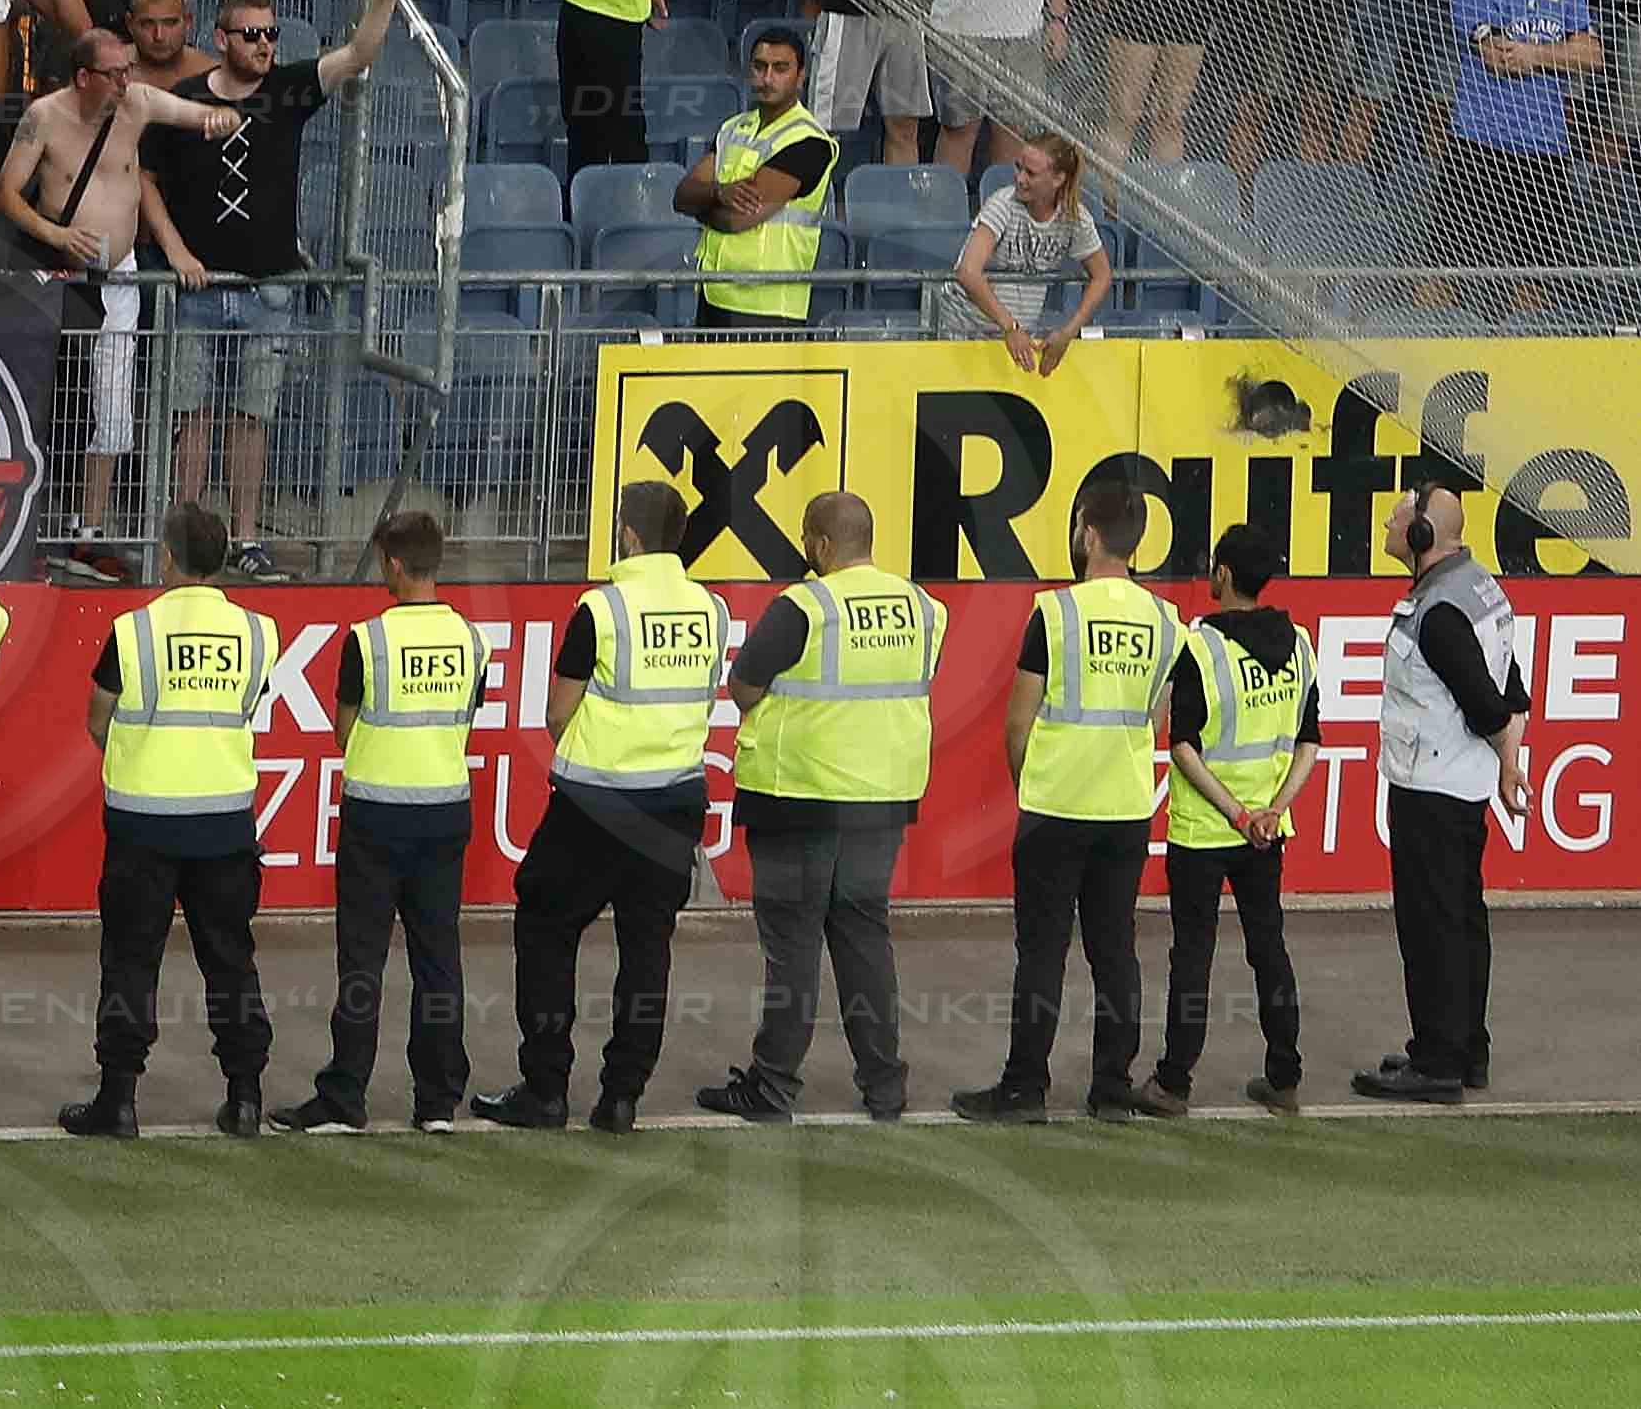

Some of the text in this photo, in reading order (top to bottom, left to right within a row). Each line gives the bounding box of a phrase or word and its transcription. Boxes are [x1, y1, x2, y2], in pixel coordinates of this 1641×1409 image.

[857, 605, 906, 629] BFS
[652, 622, 702, 648] BFS
[851, 634, 915, 648] SECURITY
[1099, 629, 1142, 658] BFS
[177, 645, 231, 670] BFS
[411, 655, 455, 677] BFS
[644, 653, 711, 668] SECURITY
[1089, 660, 1149, 677] SECURITY
[168, 676, 239, 692] SECURITY
[402, 681, 463, 694] SECURITY
